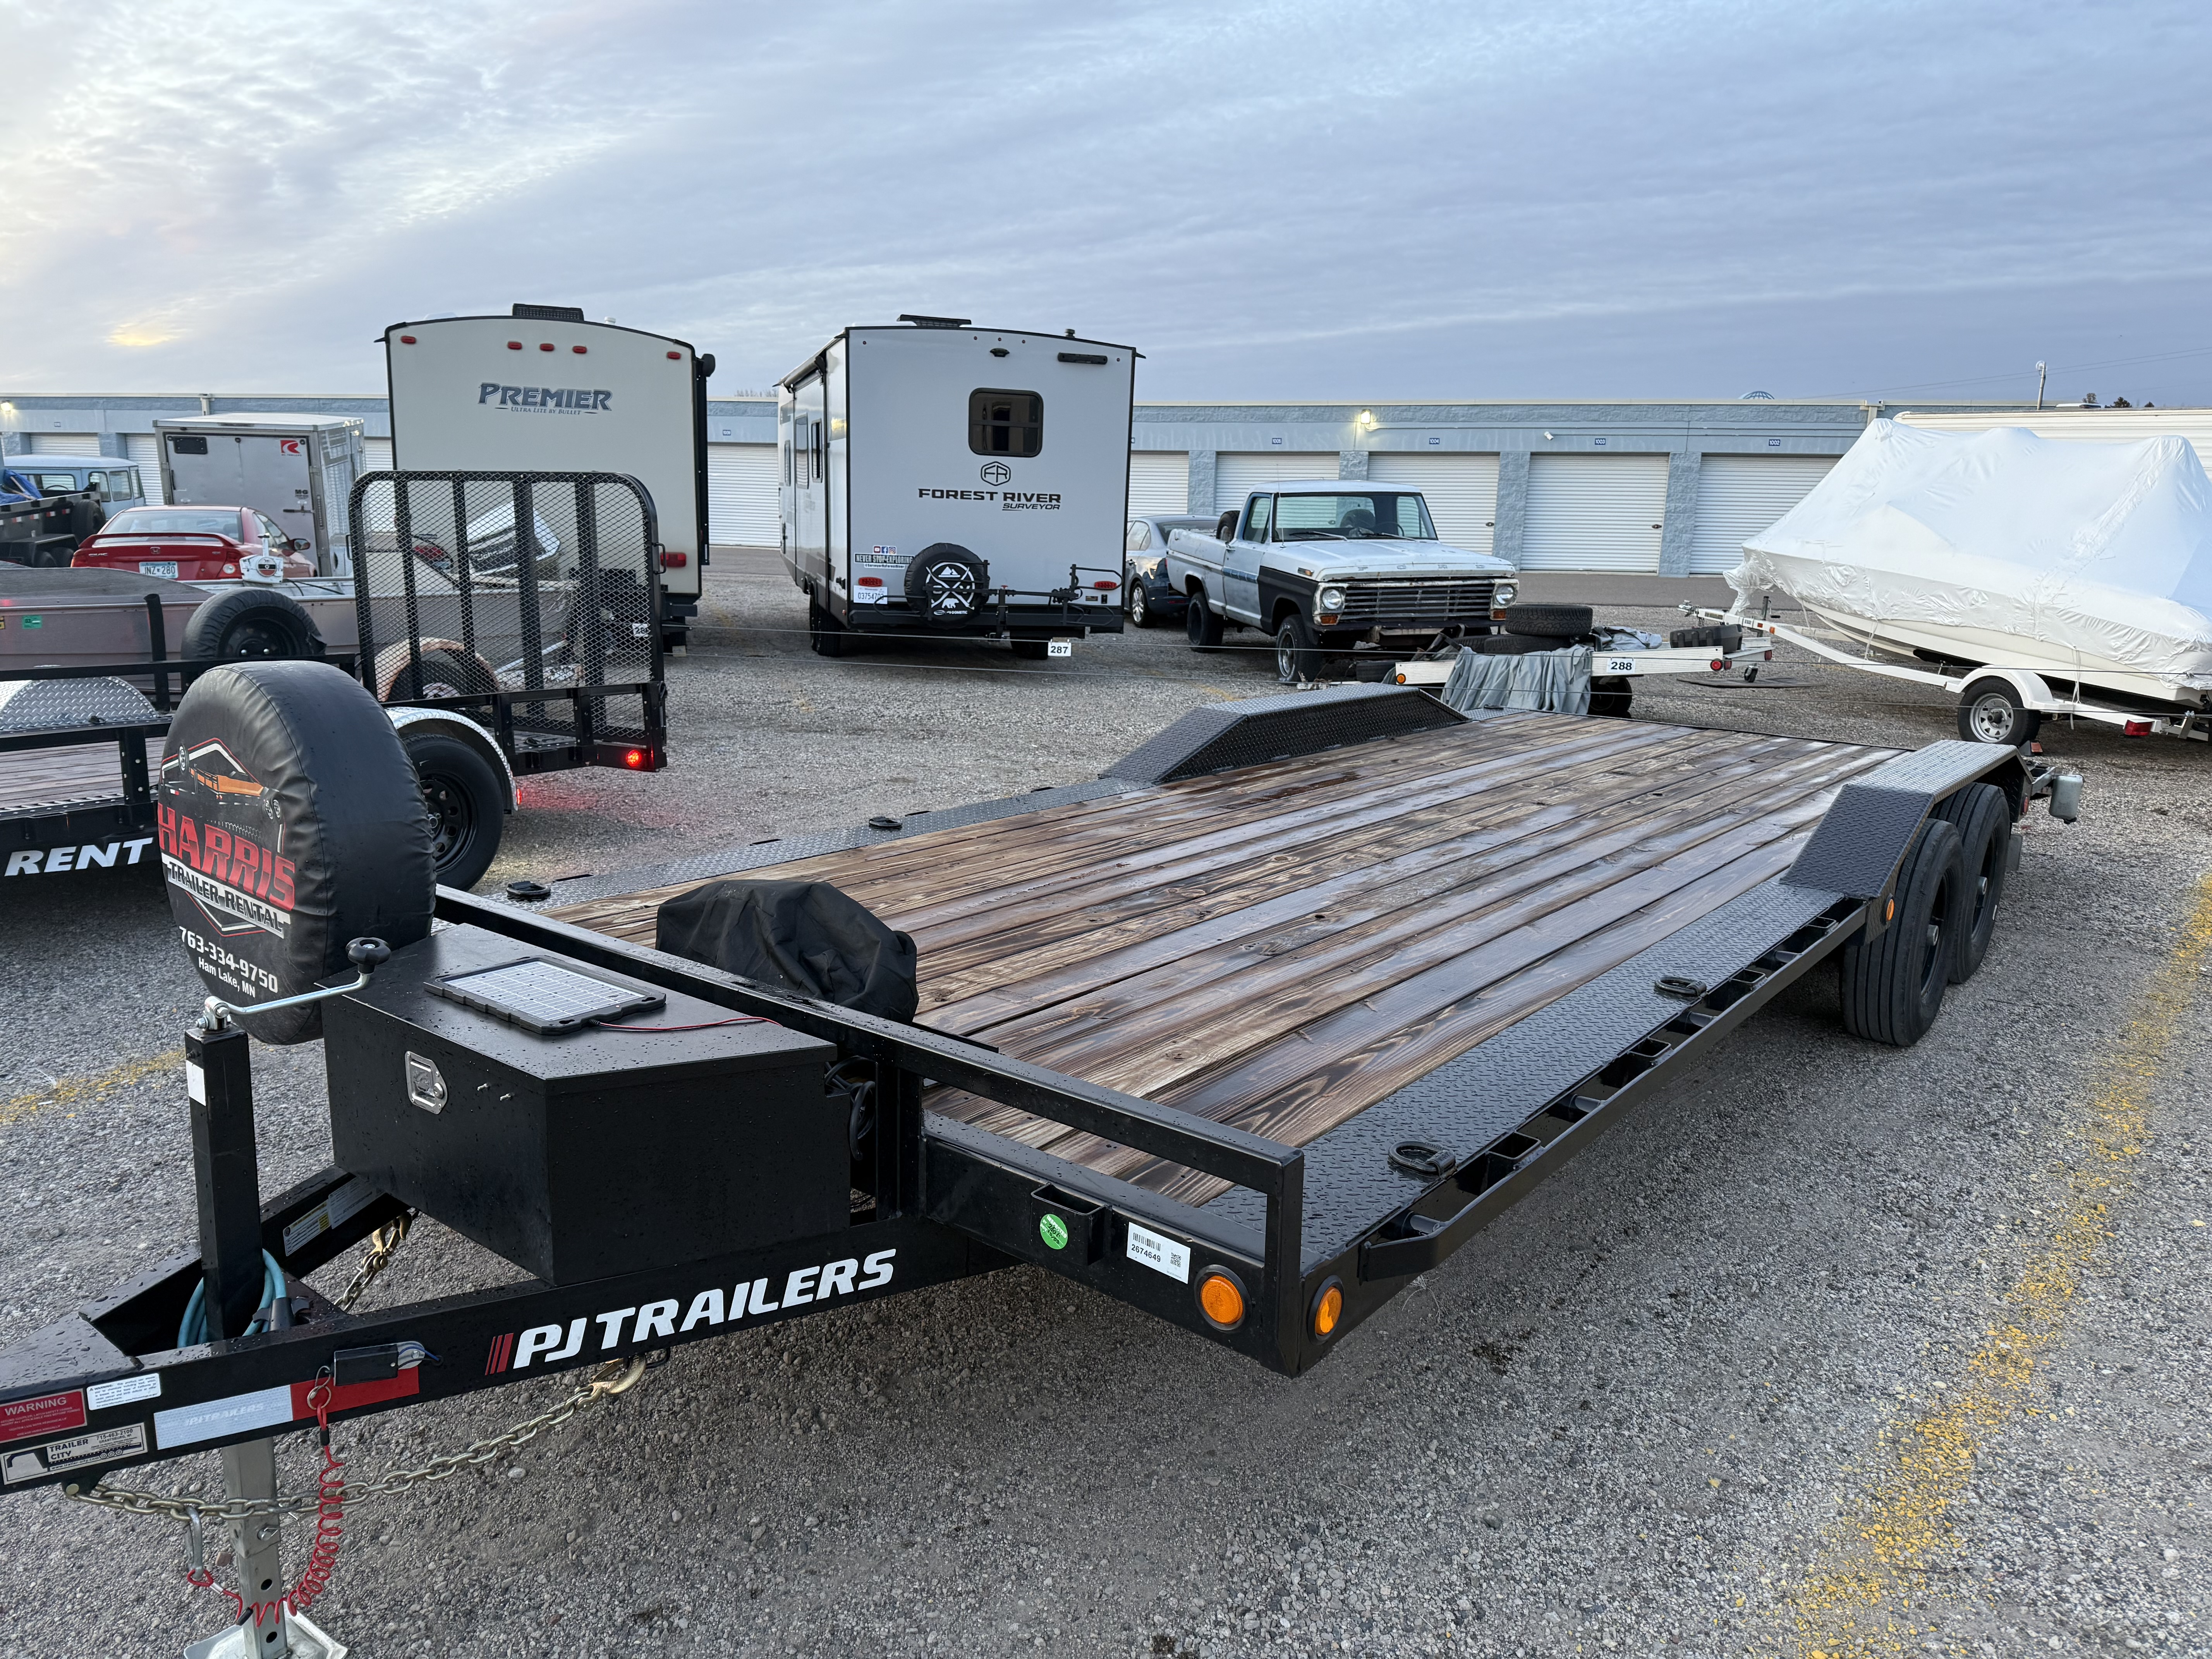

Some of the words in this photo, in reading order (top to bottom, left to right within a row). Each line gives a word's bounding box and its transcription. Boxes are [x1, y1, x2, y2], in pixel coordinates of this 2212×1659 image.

[478, 382, 612, 411] PREMIER
[918, 488, 998, 501] FOREST
[1002, 492, 1061, 503] RIVER
[856, 554, 871, 562] NEVER
[161, 566, 175, 575] 280
[1611, 661, 1632, 670] 288
[4, 837, 154, 877] RENT
[158, 802, 295, 911] HARRIS
[169, 861, 220, 906] TRAILER
[226, 890, 283, 933] RENTAL
[179, 926, 278, 993] 763-334-9750
[198, 957, 216, 976] Ham
[218, 970, 239, 991] Lake,
[242, 980, 256, 998] MN
[1047, 1215, 1066, 1238] INSPECTED
[1131, 1244, 1161, 1262] 2674649
[513, 1317, 587, 1369] PJ
[595, 1249, 896, 1350] TRAILERS
[5, 1397, 67, 1416] WARNING
[96, 1429, 133, 1440] 715-463-2100
[49, 1439, 89, 1452] TRAILER
[51, 1451, 71, 1460] CITY
[52, 1456, 100, 1470] www.trailer-city.com
